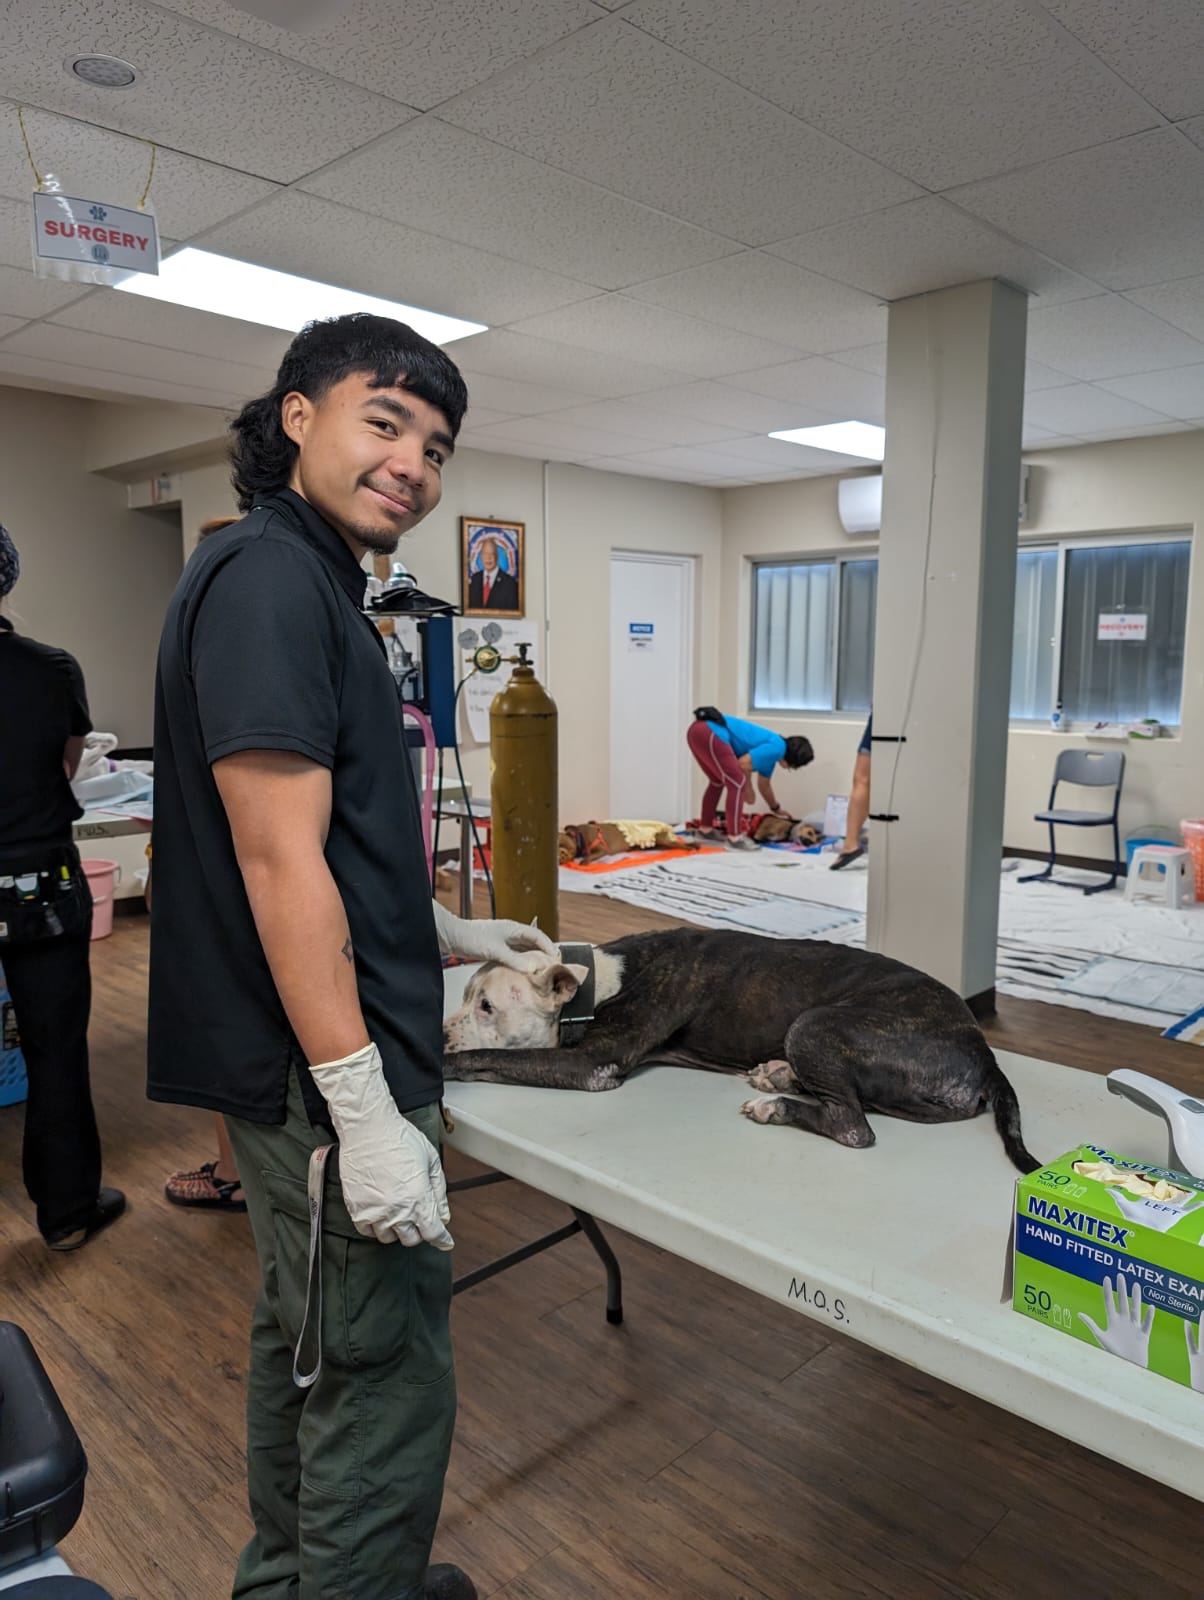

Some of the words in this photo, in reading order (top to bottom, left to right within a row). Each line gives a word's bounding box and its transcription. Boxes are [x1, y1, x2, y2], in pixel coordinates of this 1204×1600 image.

[44, 220, 149, 251] SURGERY
[1085, 1144, 1178, 1180] MAXITEX
[1039, 1170, 1071, 1185] 50
[1028, 1195, 1128, 1249] MAXITEX
[1144, 1200, 1181, 1216] LEFT
[1025, 1223, 1063, 1247] HAND
[1065, 1239, 1114, 1266] FITTED
[1117, 1258, 1164, 1287] LATEX
[1168, 1277, 1204, 1301] EXA
[1023, 1284, 1052, 1311] 50
[1148, 1289, 1166, 1302] Non
[1167, 1296, 1195, 1313] Sterile
